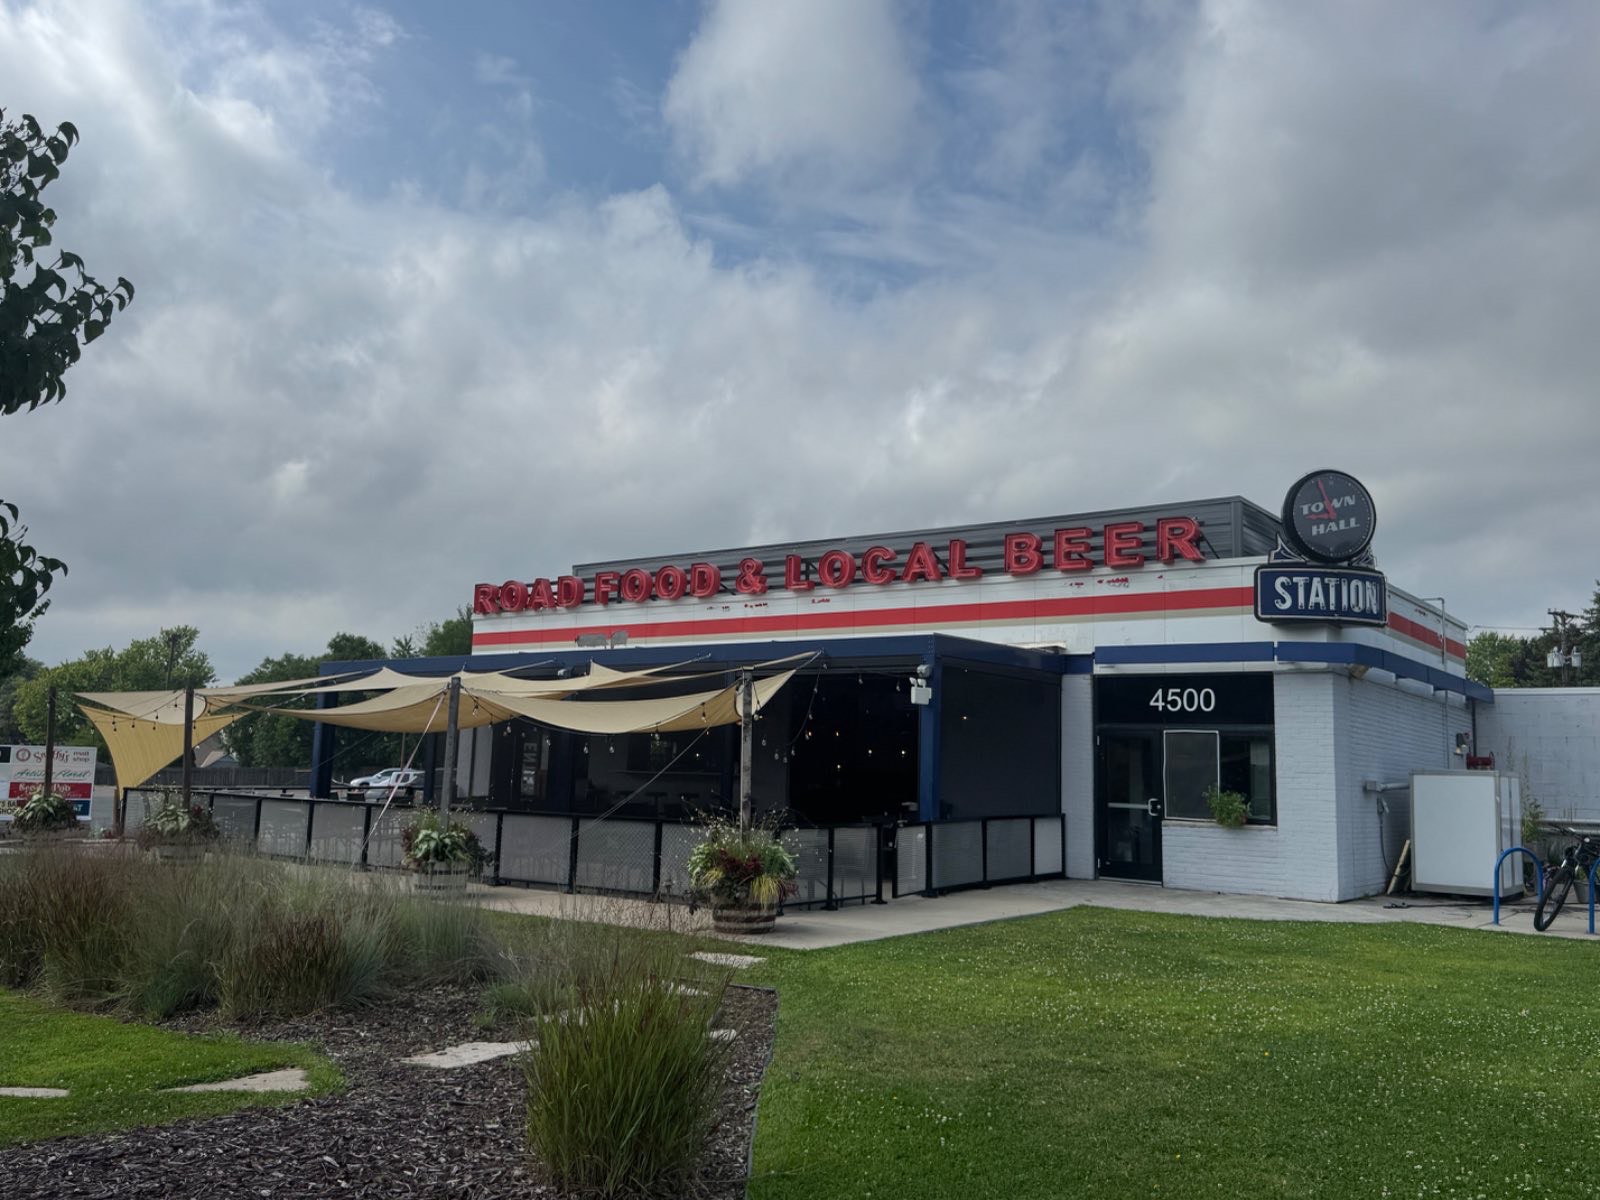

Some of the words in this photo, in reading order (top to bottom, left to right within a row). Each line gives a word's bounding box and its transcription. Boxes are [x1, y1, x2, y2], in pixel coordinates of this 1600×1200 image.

[1311, 517, 1360, 537] HALL
[473, 575, 585, 615] ROAD
[594, 562, 720, 605] FOOD
[735, 557, 768, 594] &
[785, 538, 983, 592] LOCAL
[1004, 516, 1206, 576] BEER
[1274, 575, 1379, 615] STATION
[1149, 687, 1217, 713] 4500
